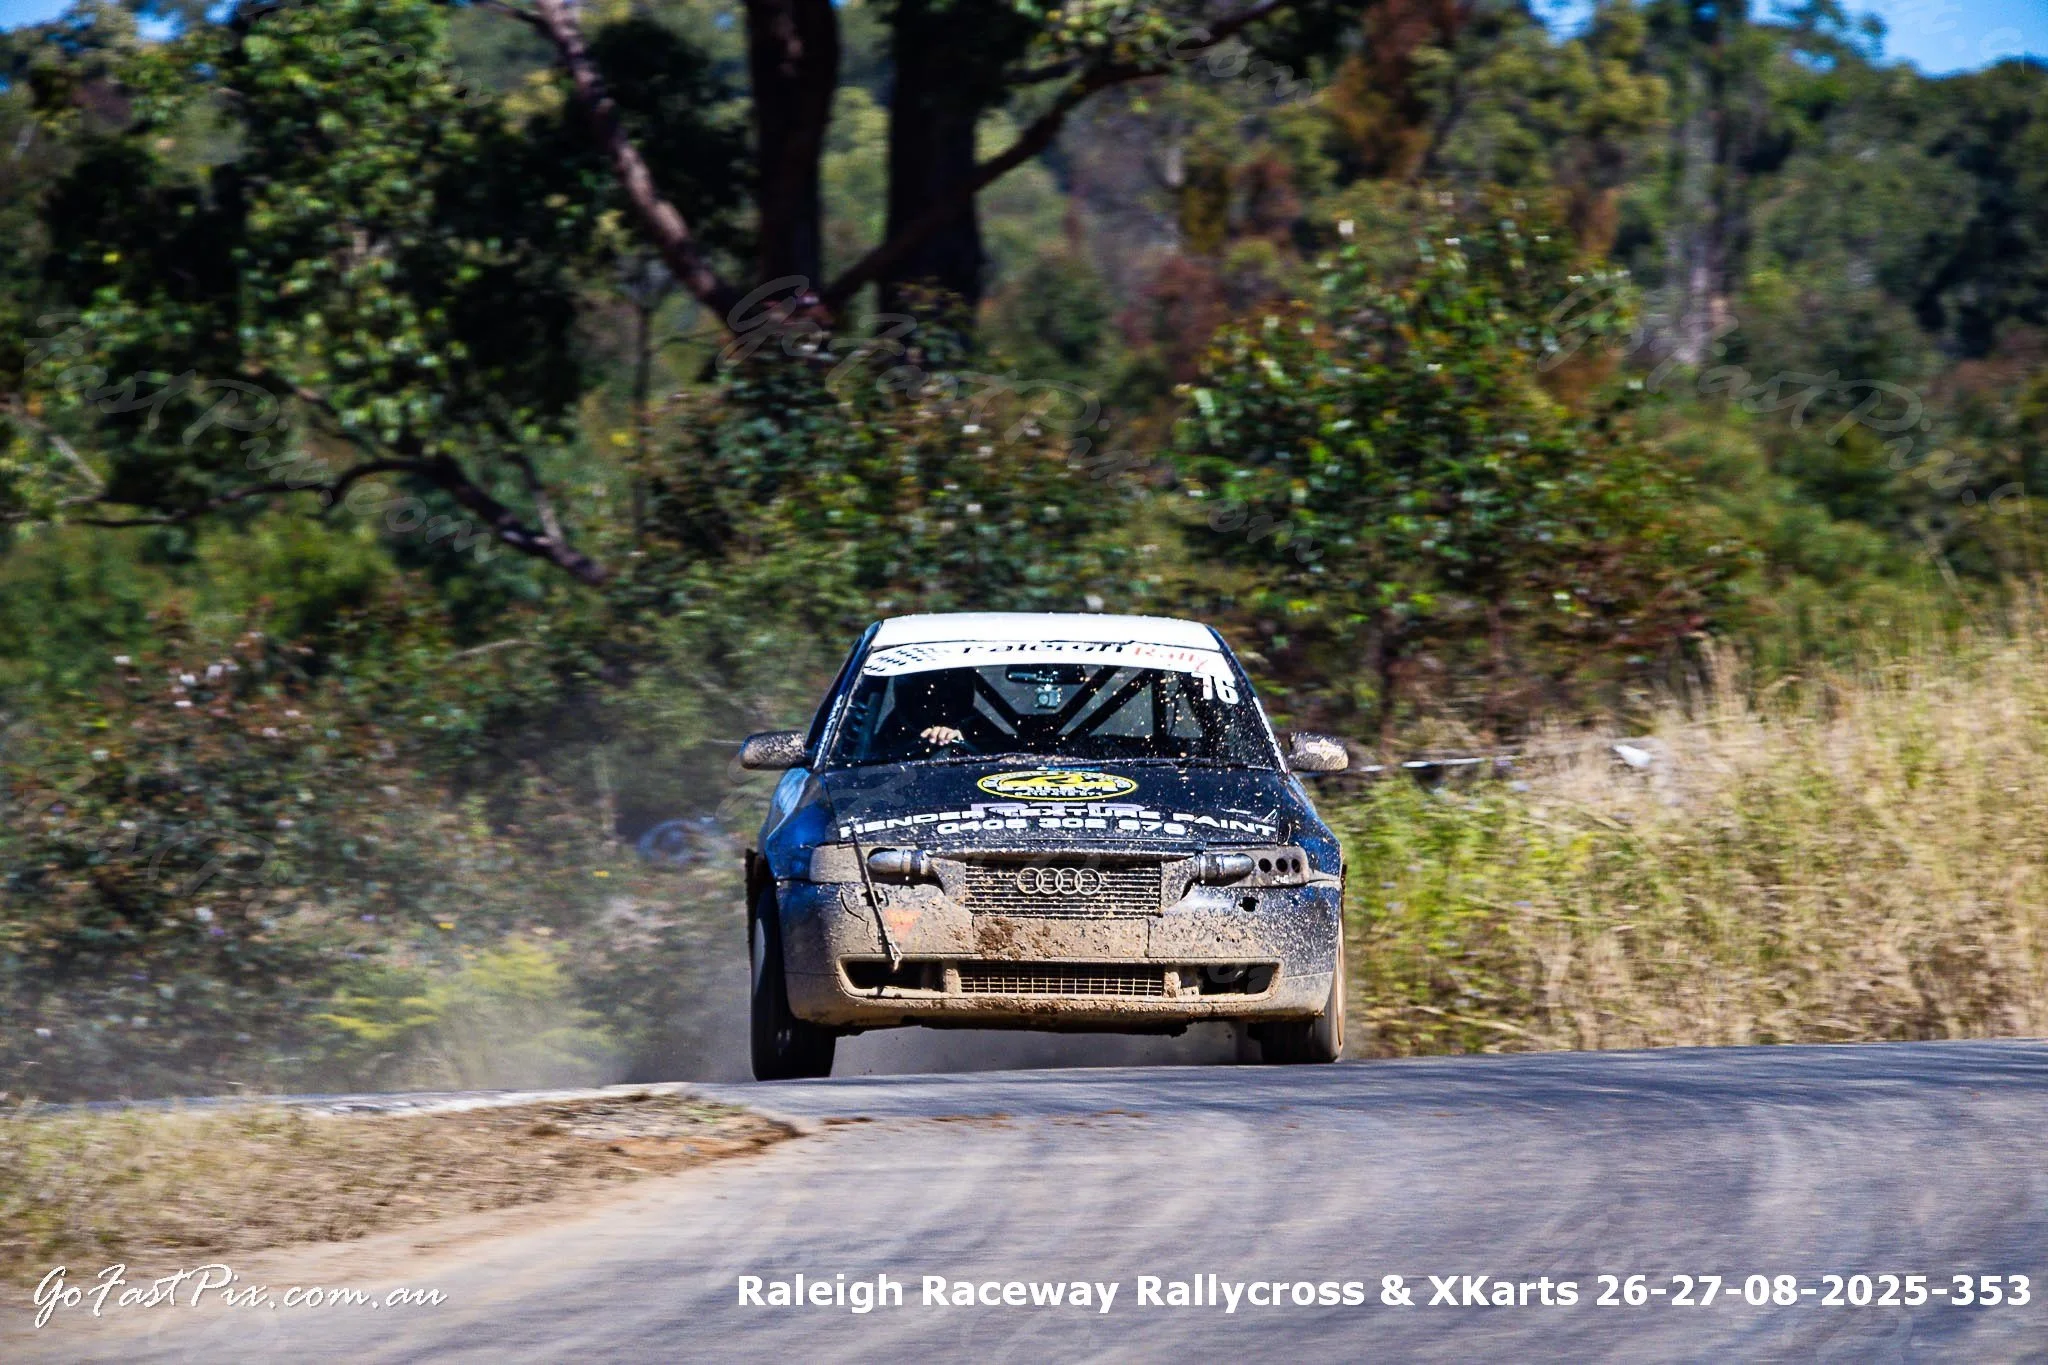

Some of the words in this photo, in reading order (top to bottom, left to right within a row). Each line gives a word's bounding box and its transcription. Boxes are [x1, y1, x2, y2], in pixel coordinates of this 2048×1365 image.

[839, 810, 986, 839] RENDER
[998, 808, 1161, 820] TEXTURE
[1173, 812, 1277, 837] PAINT
[1038, 817, 1107, 829] 302
